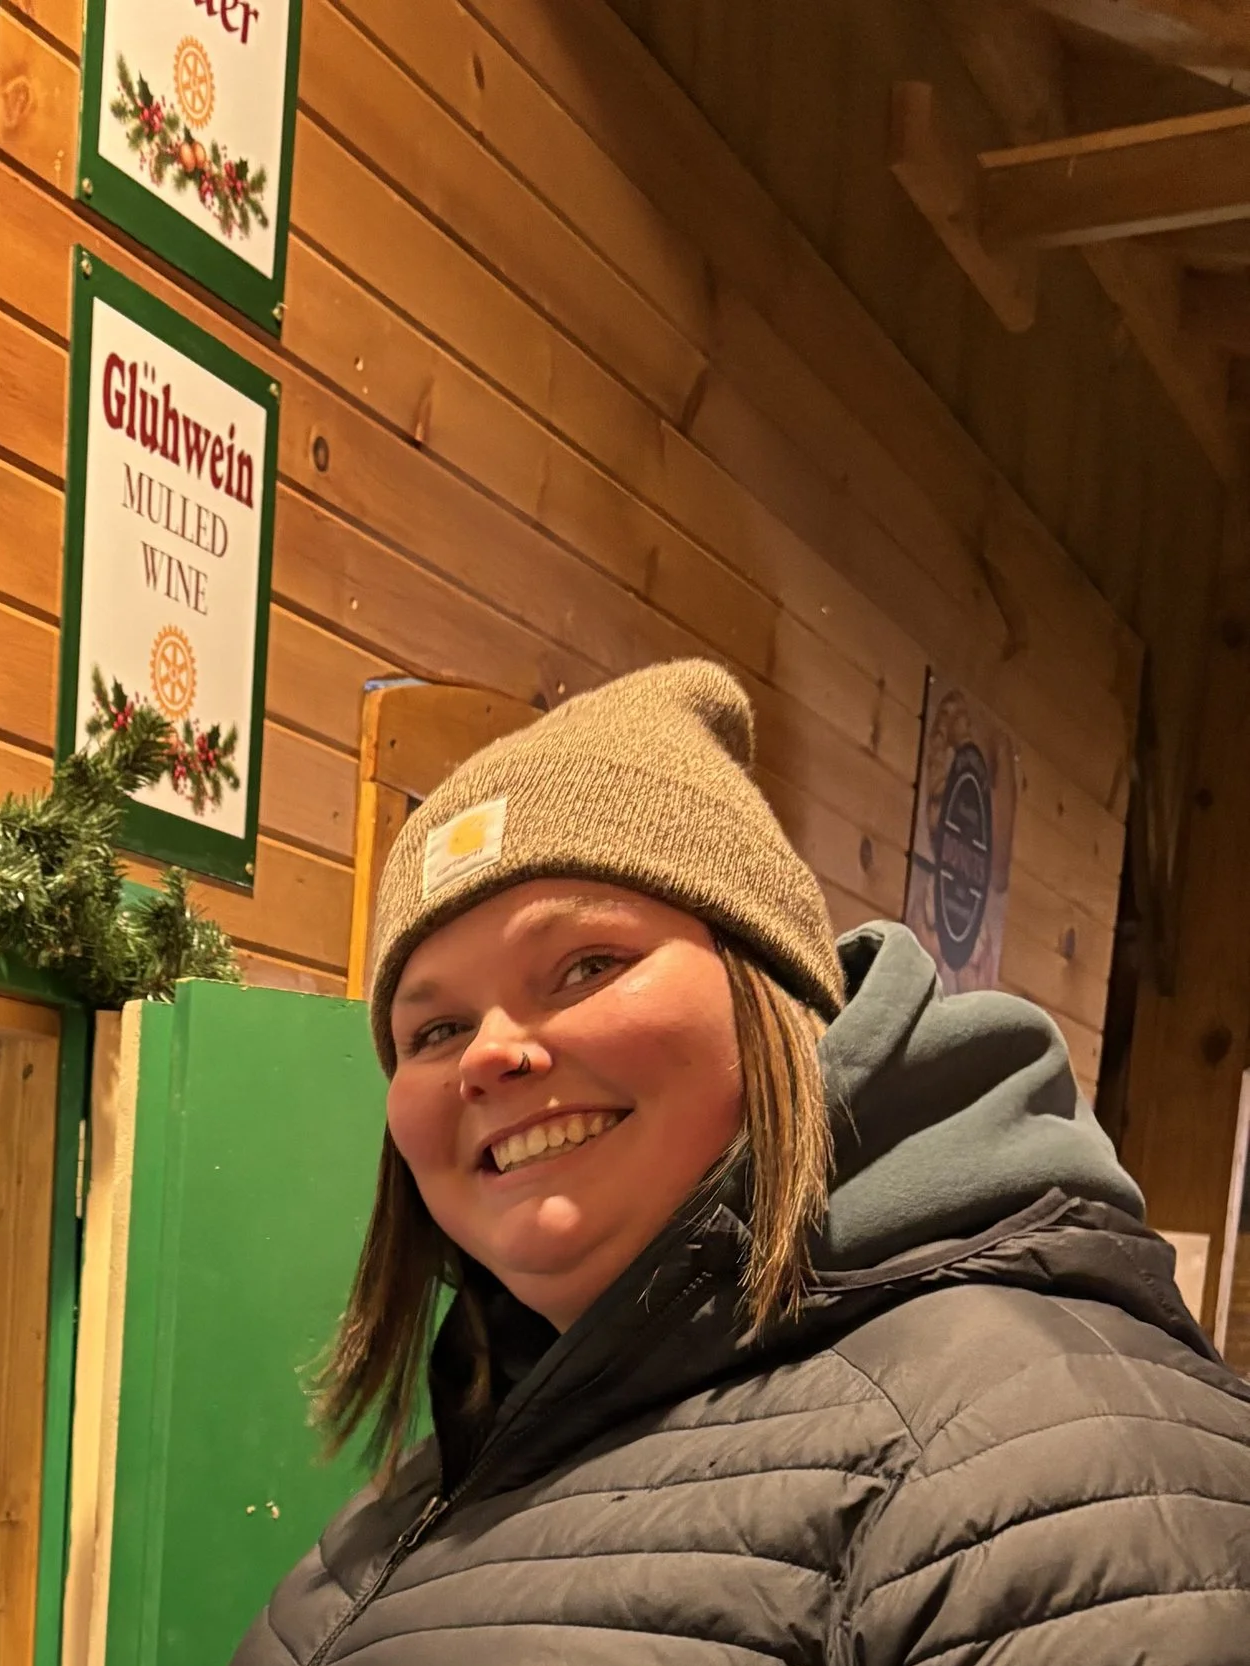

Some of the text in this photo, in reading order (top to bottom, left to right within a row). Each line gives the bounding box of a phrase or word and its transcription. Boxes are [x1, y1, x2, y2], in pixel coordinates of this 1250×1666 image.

[103, 352, 254, 509] Glühwein
[122, 462, 228, 558] MULLED
[141, 540, 208, 616] WINE
